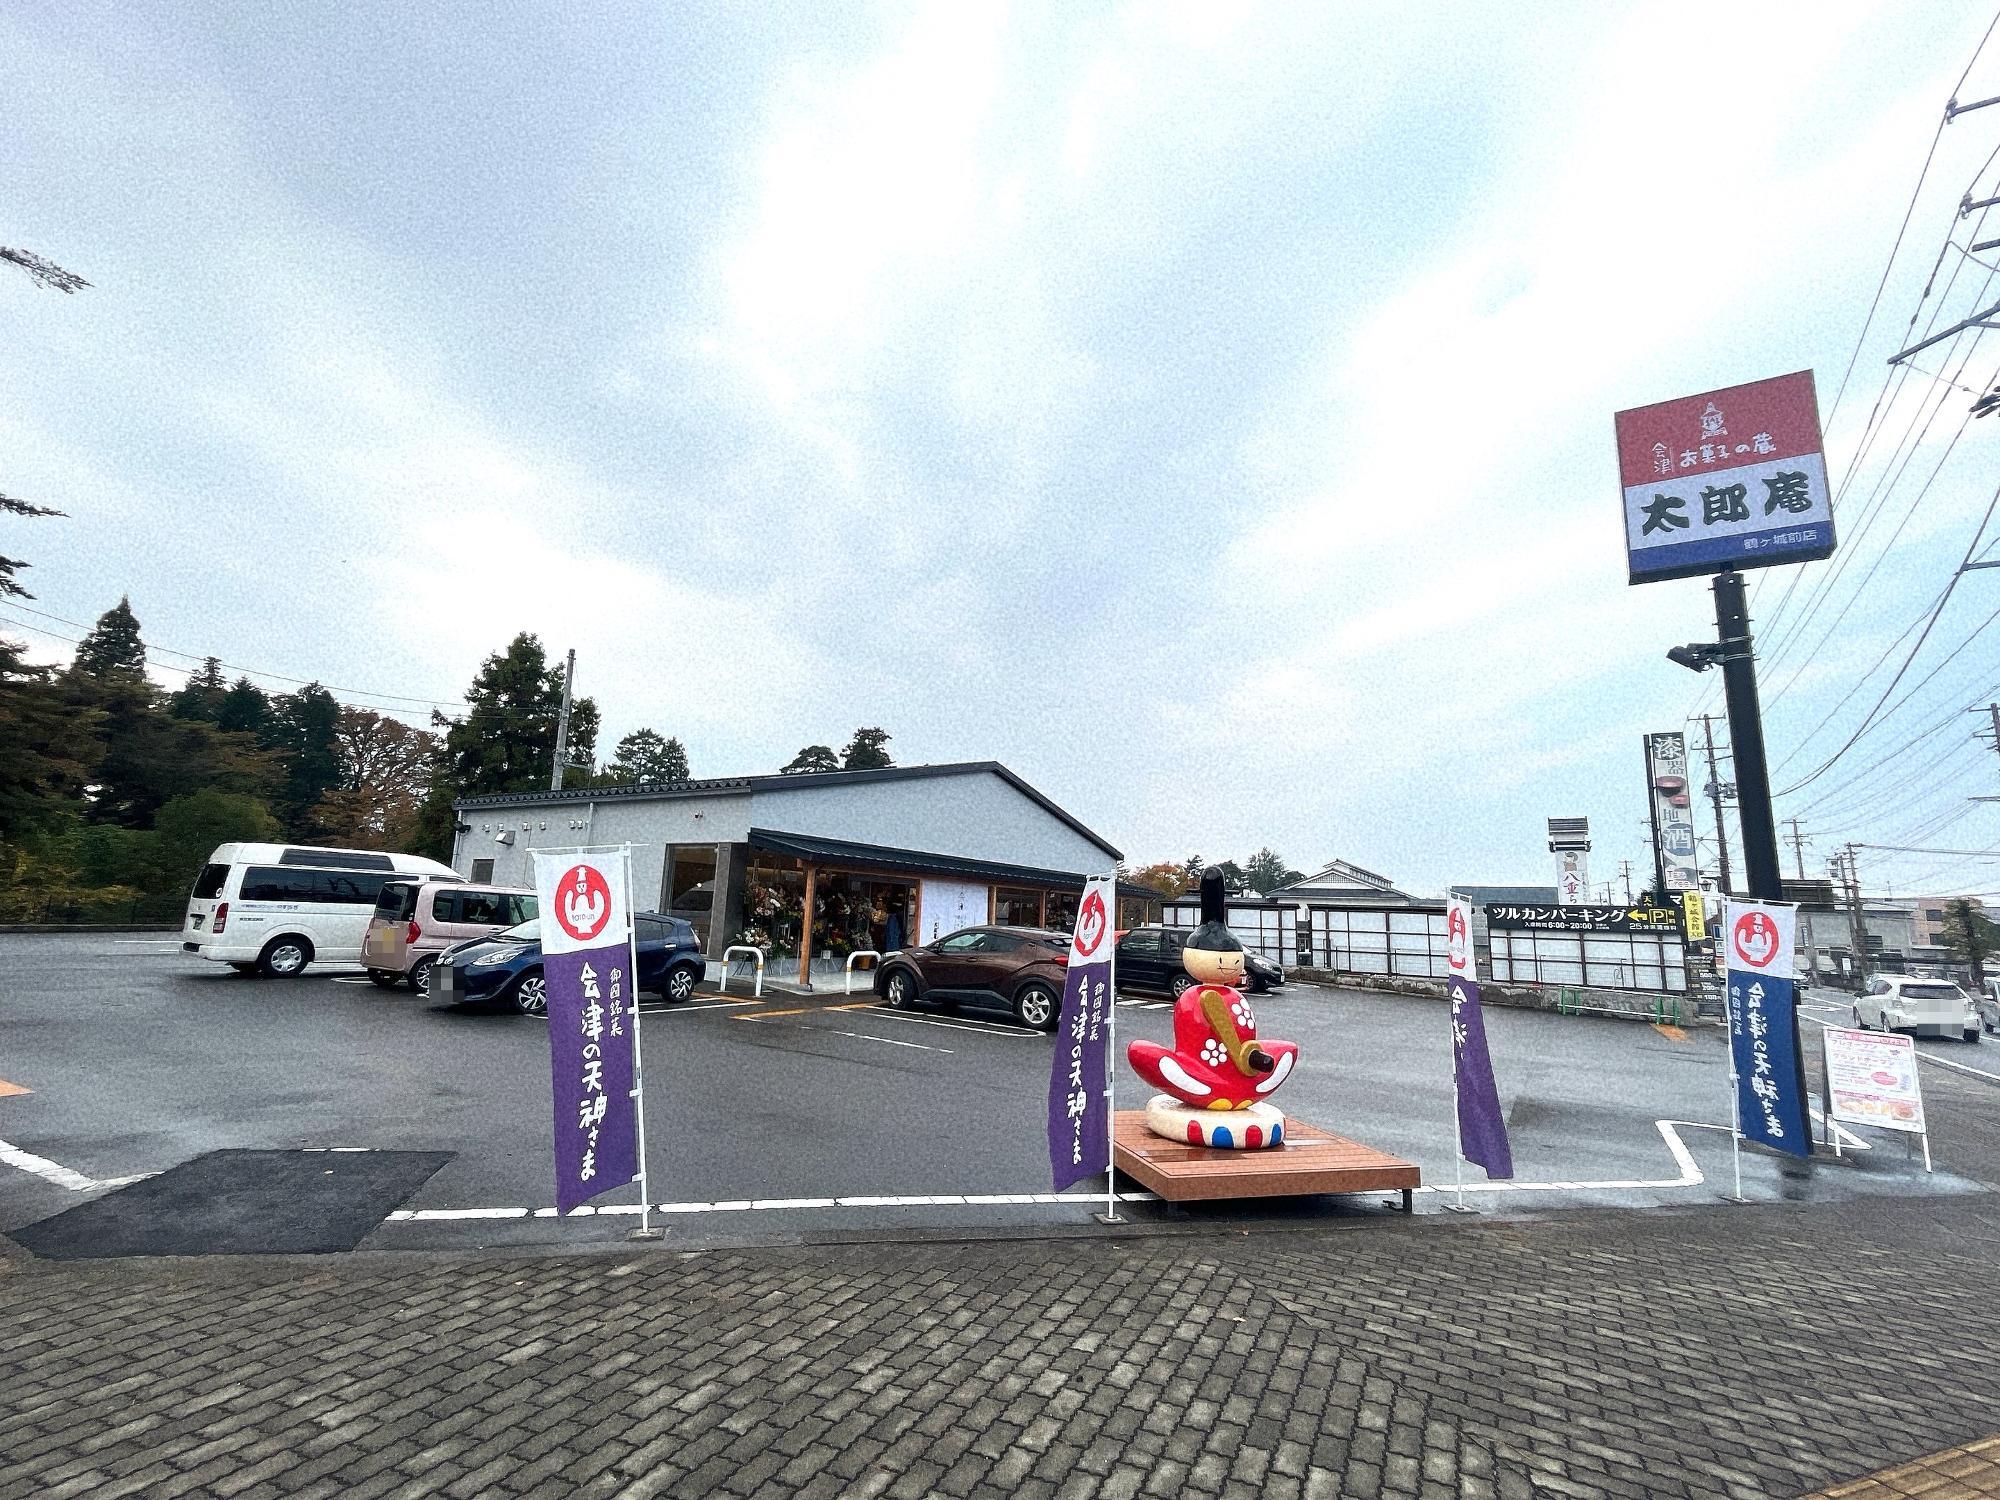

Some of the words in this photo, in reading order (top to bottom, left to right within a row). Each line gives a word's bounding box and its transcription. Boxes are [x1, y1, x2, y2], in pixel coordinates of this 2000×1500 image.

[1651, 442, 1672, 475] 会津
[1680, 432, 1777, 468] お菓子の蔵
[1641, 471, 1813, 536] 太郎庵
[1743, 529, 1818, 550] 鶴ヶ城前店
[1493, 907, 1627, 923] ツルカンパーキング
[579, 961, 608, 1182] 会津の天神さま
[1066, 974, 1088, 1165] 会津の天神さま
